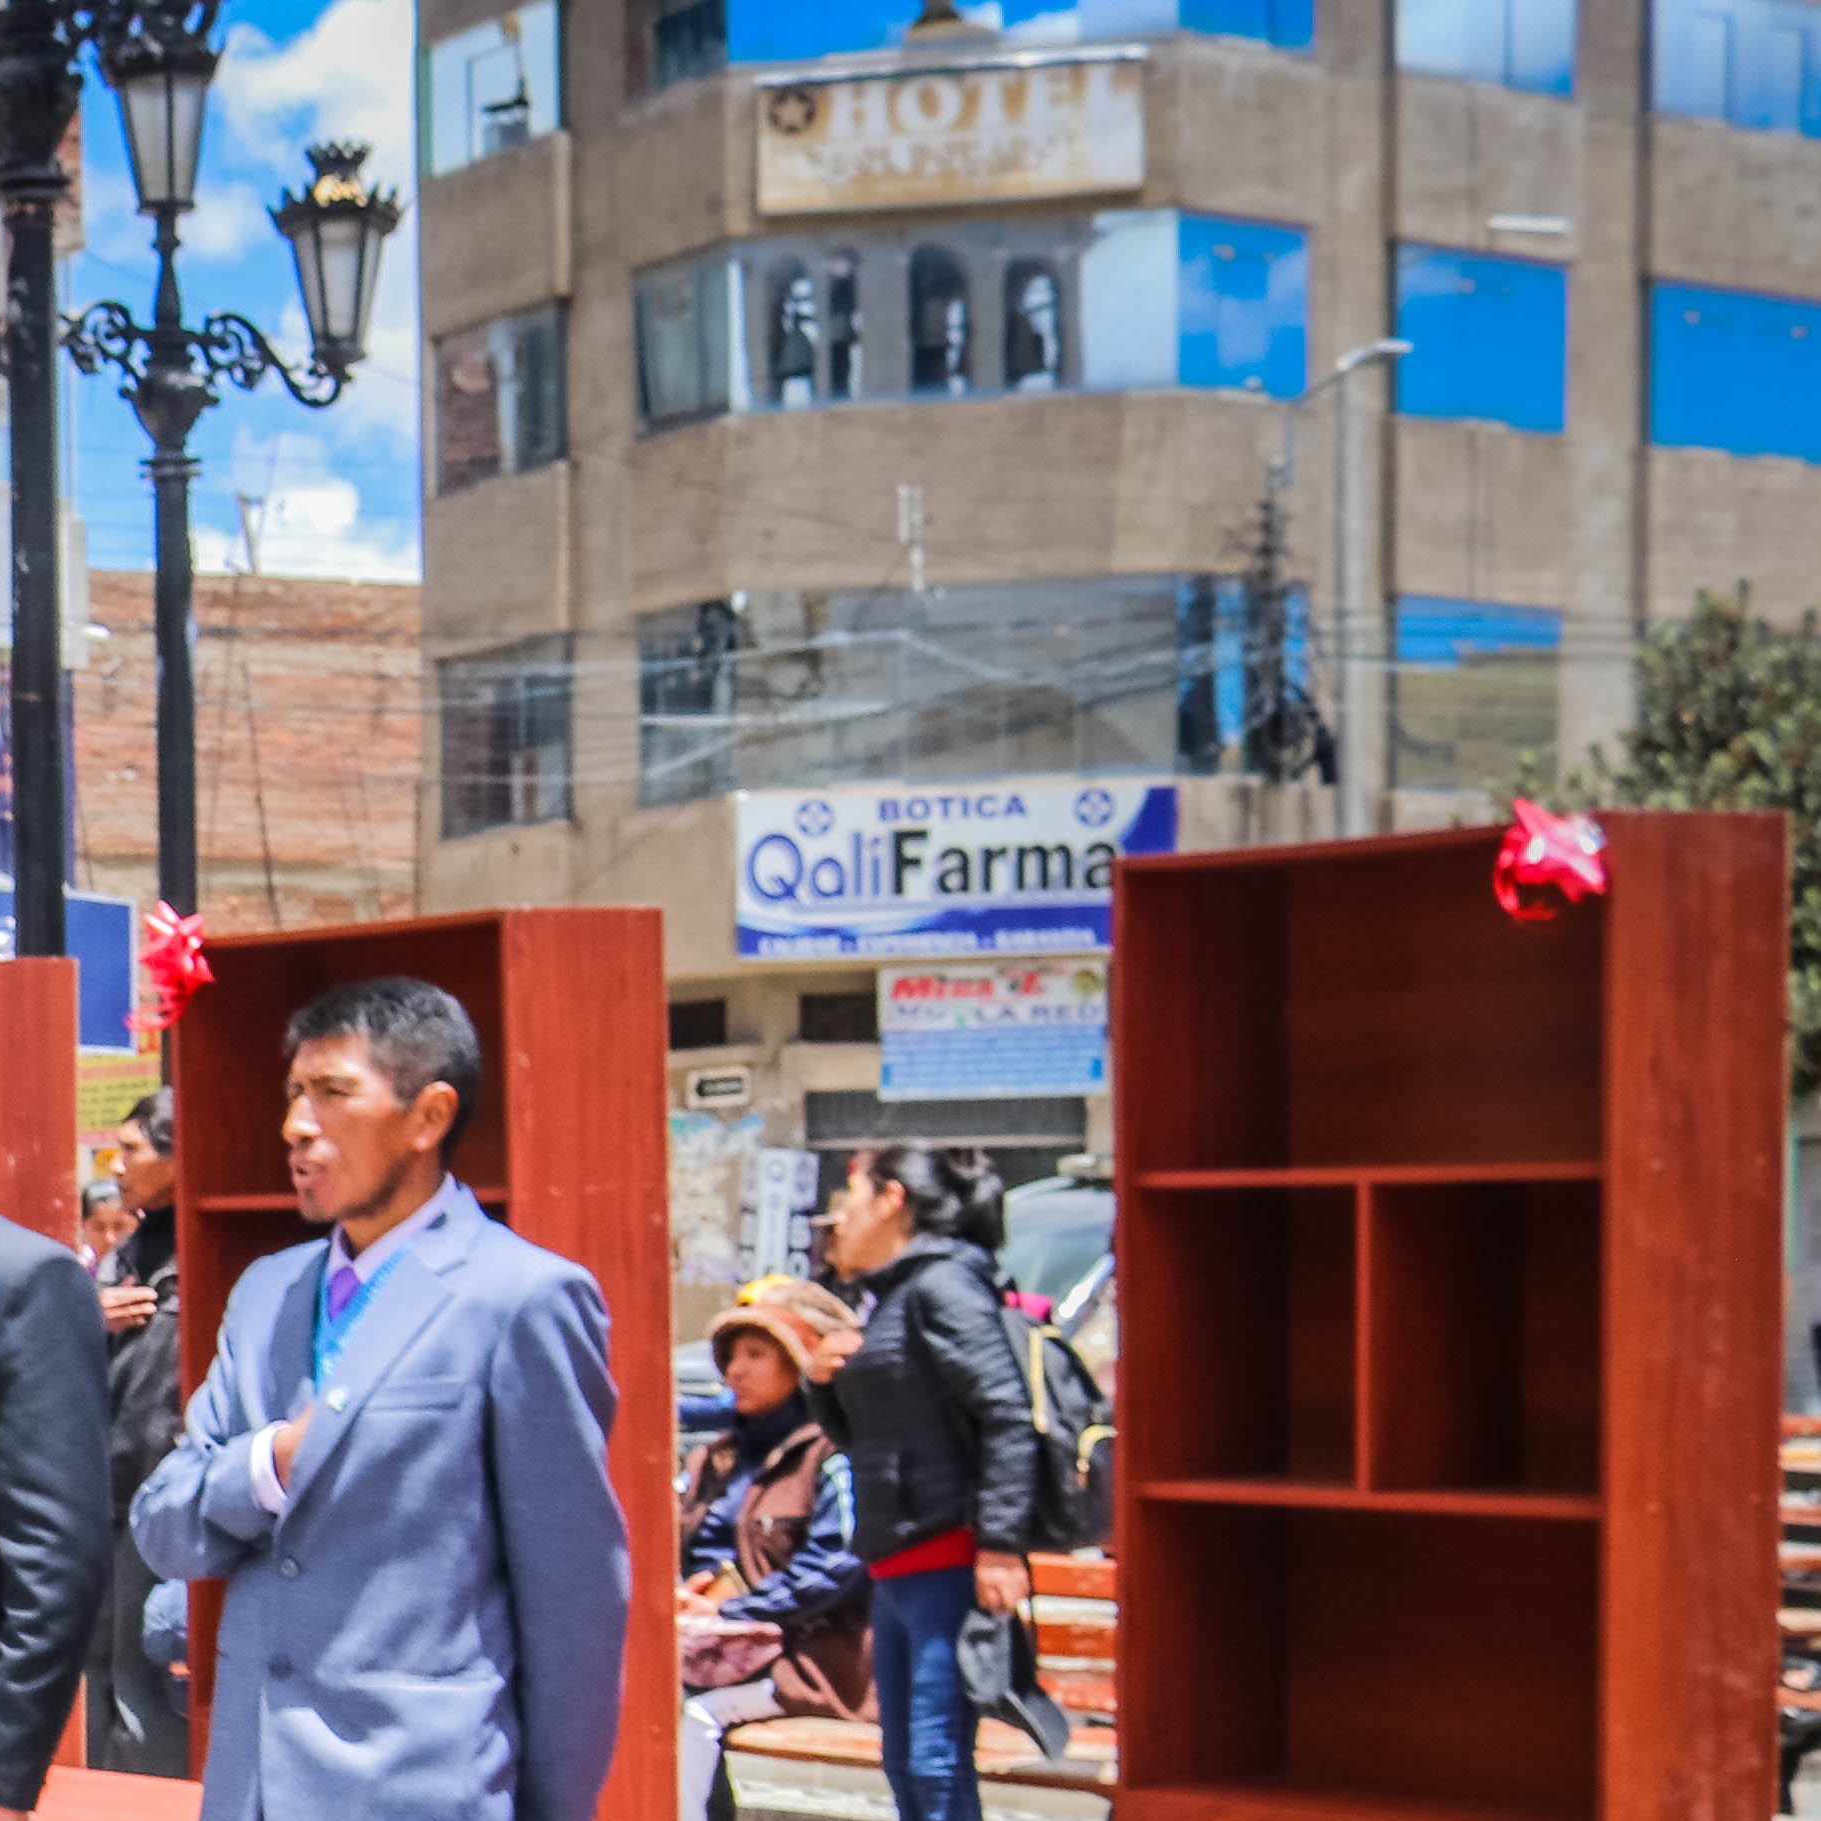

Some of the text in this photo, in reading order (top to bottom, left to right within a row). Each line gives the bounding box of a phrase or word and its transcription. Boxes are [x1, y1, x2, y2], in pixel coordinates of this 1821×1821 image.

[828, 64, 1135, 138] HOTEL
[877, 793, 1028, 822] BOTICA
[747, 828, 1116, 901] QaliFarma
